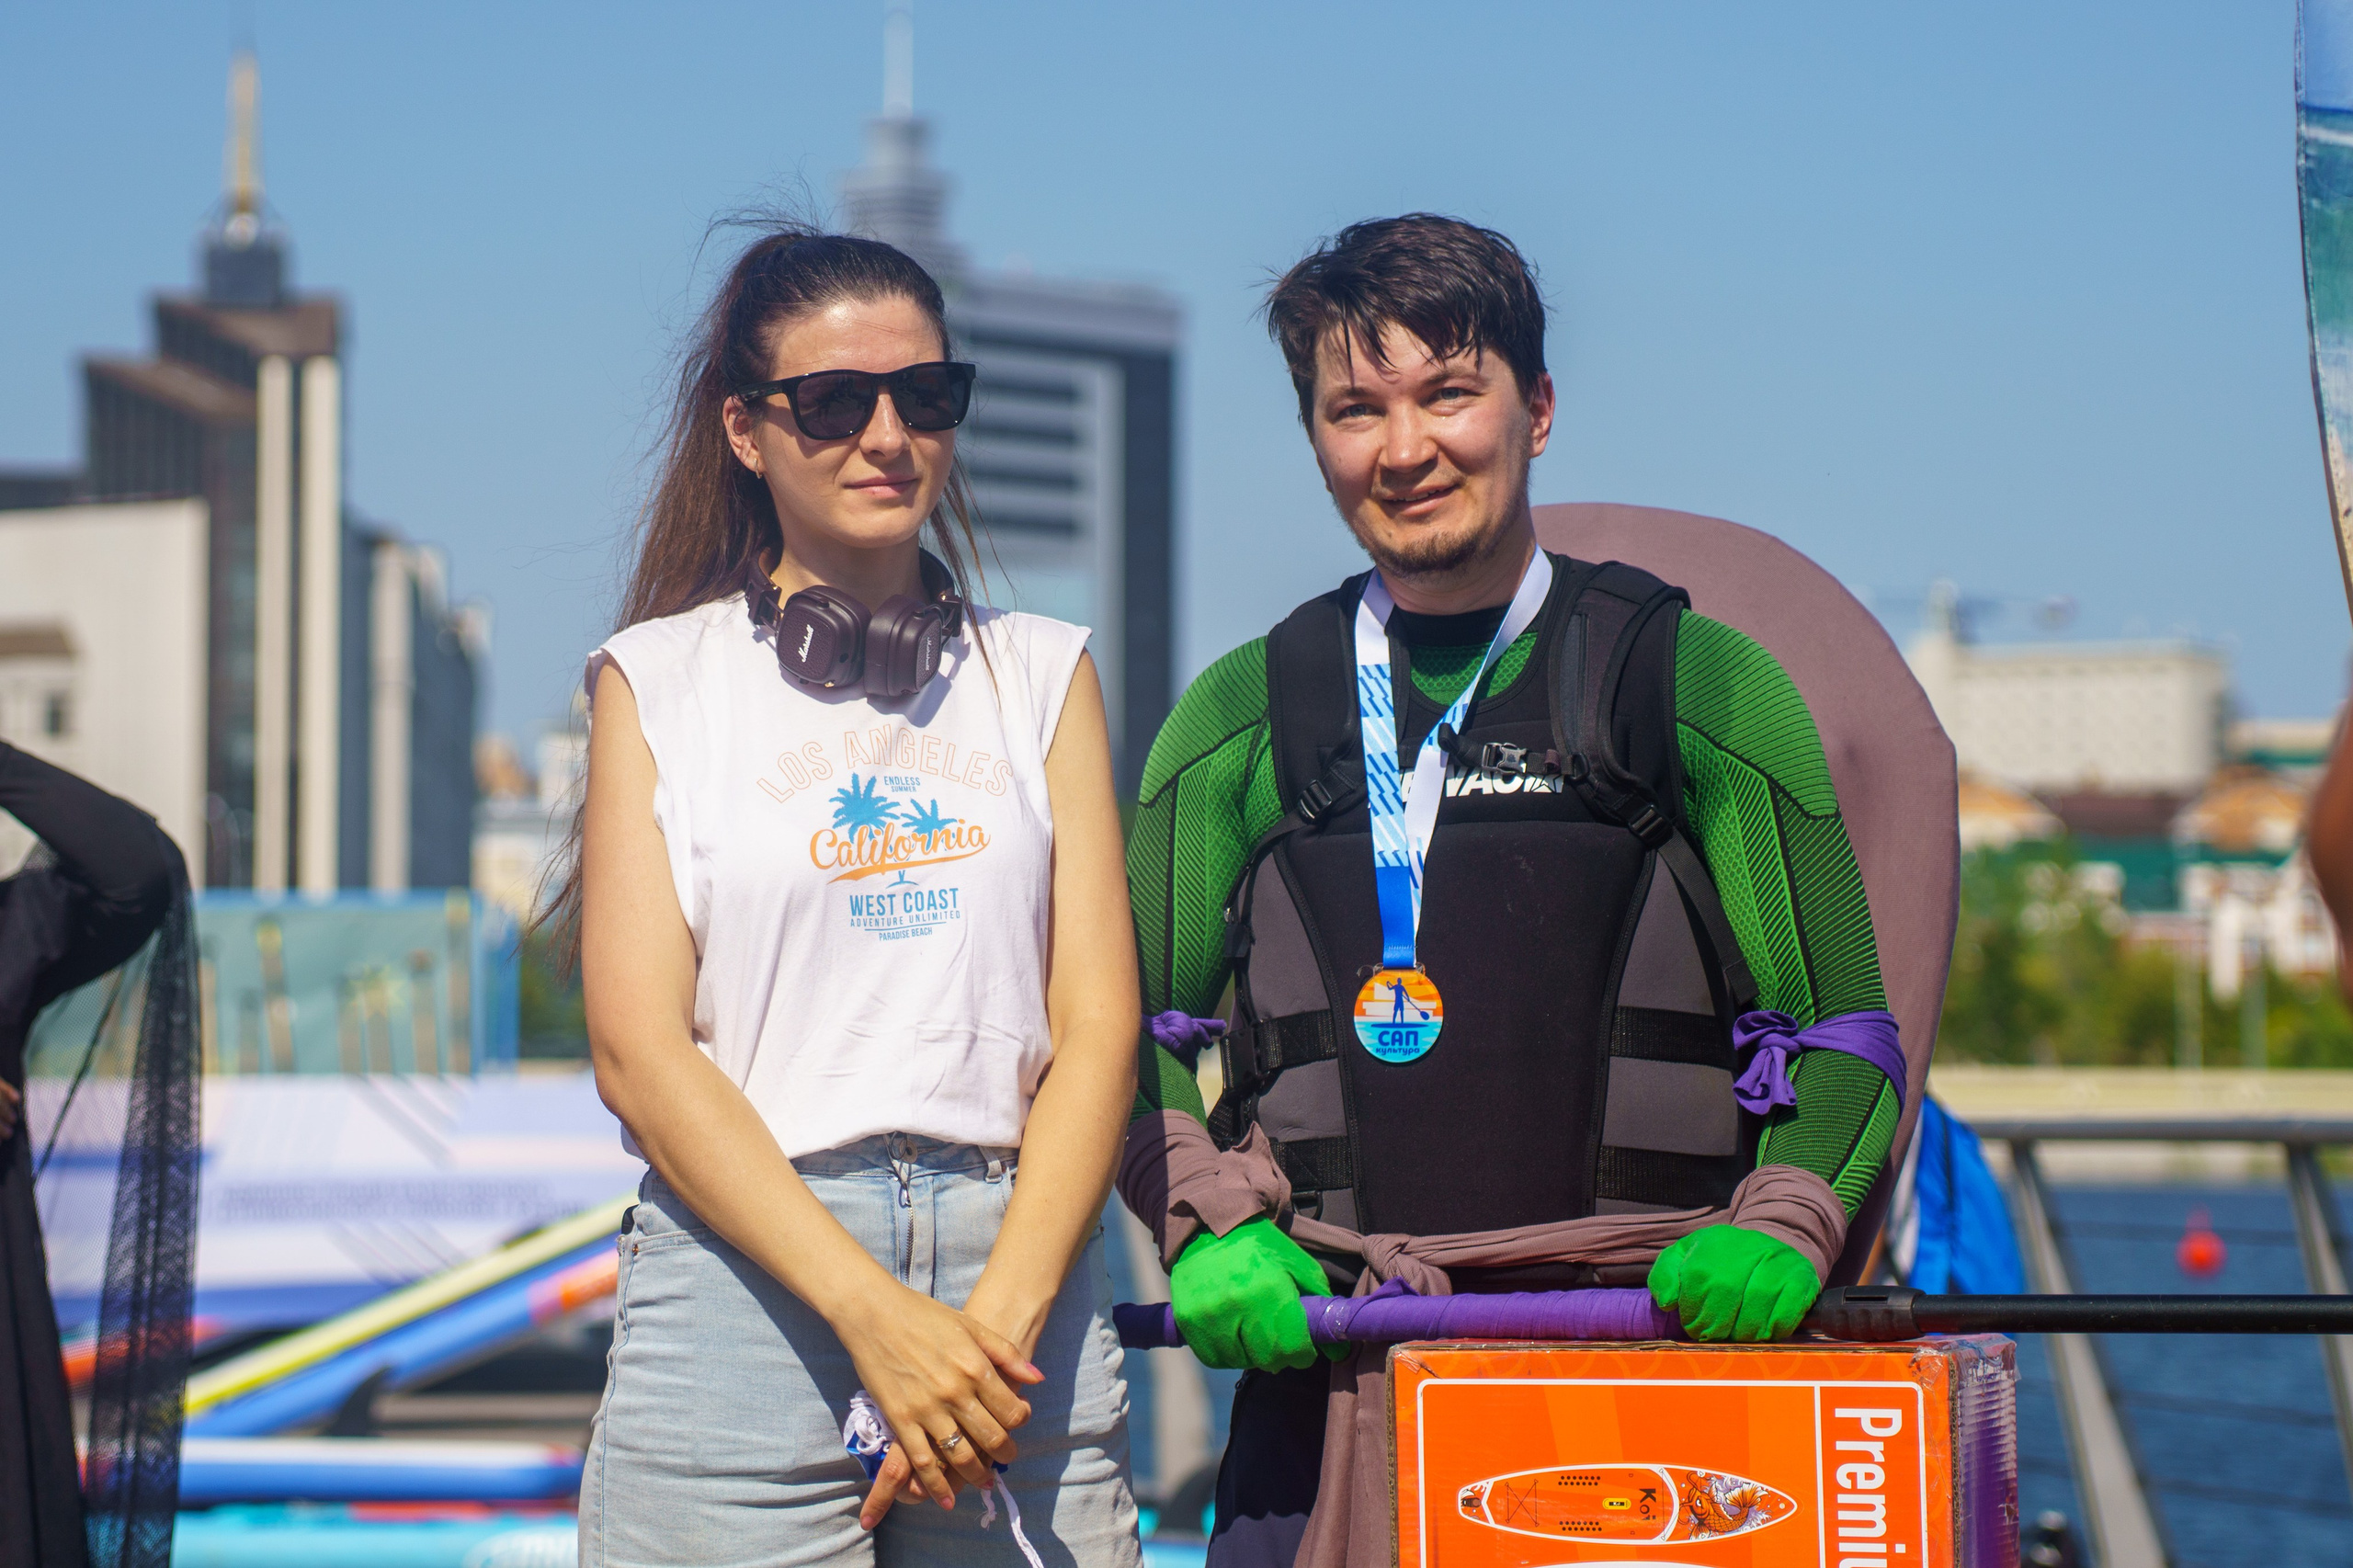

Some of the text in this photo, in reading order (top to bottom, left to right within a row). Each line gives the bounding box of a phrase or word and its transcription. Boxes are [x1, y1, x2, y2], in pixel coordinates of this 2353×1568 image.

[798, 624, 814, 663] Marshall
[756, 724, 1014, 803] LOS ANGELES
[883, 776, 921, 787] ENDLESS
[891, 785, 917, 793] SUMMER
[810, 819, 991, 875] California
[849, 888, 959, 916] WEST COAST
[850, 910, 961, 927] ADVENTURE UNLIMITED
[879, 926, 933, 941] PARADISE BEACH
[1377, 1030, 1419, 1047] САП
[1376, 1047, 1420, 1056] культура
